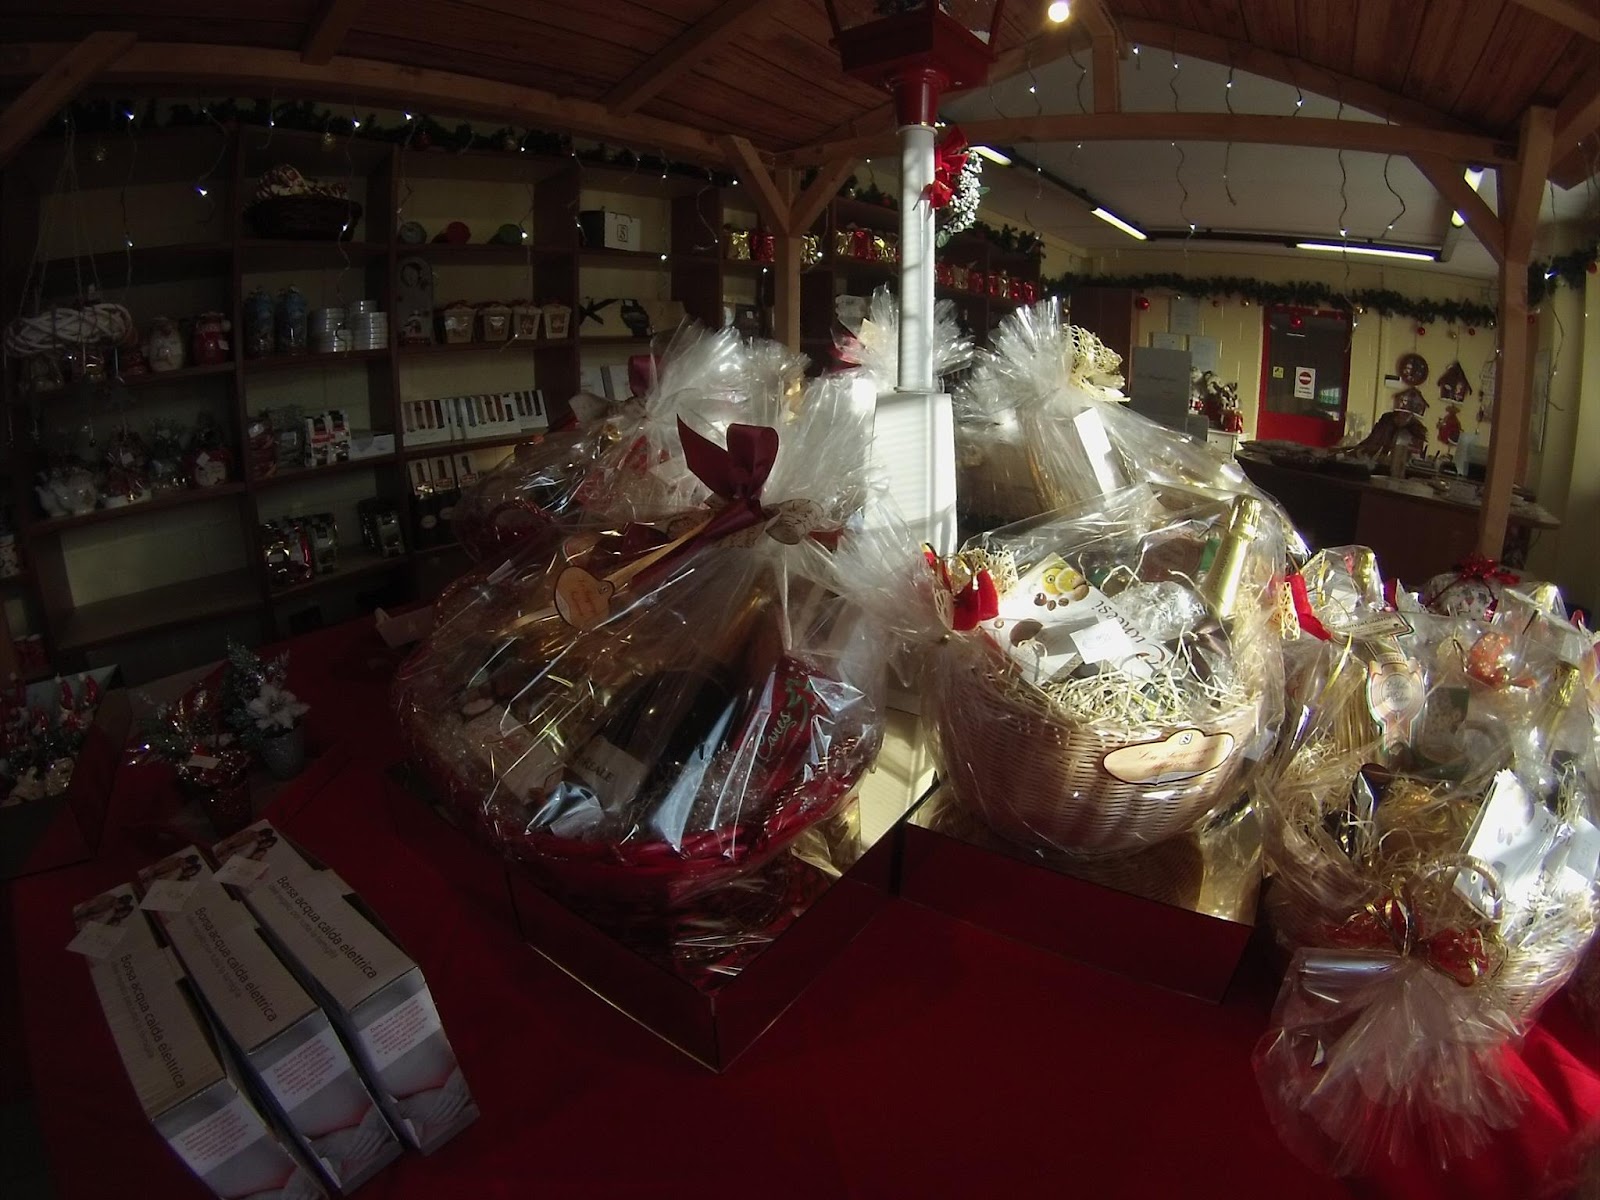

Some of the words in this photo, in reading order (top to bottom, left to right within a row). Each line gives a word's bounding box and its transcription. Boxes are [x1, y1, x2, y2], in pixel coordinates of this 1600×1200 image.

[194, 906, 213, 930] Borsa
[208, 929, 230, 957] acqua
[226, 956, 248, 983] calda
[244, 982, 277, 1022] elettrica
[276, 874, 298, 900] Borsa
[295, 896, 320, 922] acqua
[317, 920, 342, 945] calda
[339, 942, 377, 979] elettrica
[119, 953, 136, 981] Borsa
[131, 981, 150, 1012] acqua
[143, 1012, 163, 1042] calda
[157, 1042, 185, 1090] elettrica
